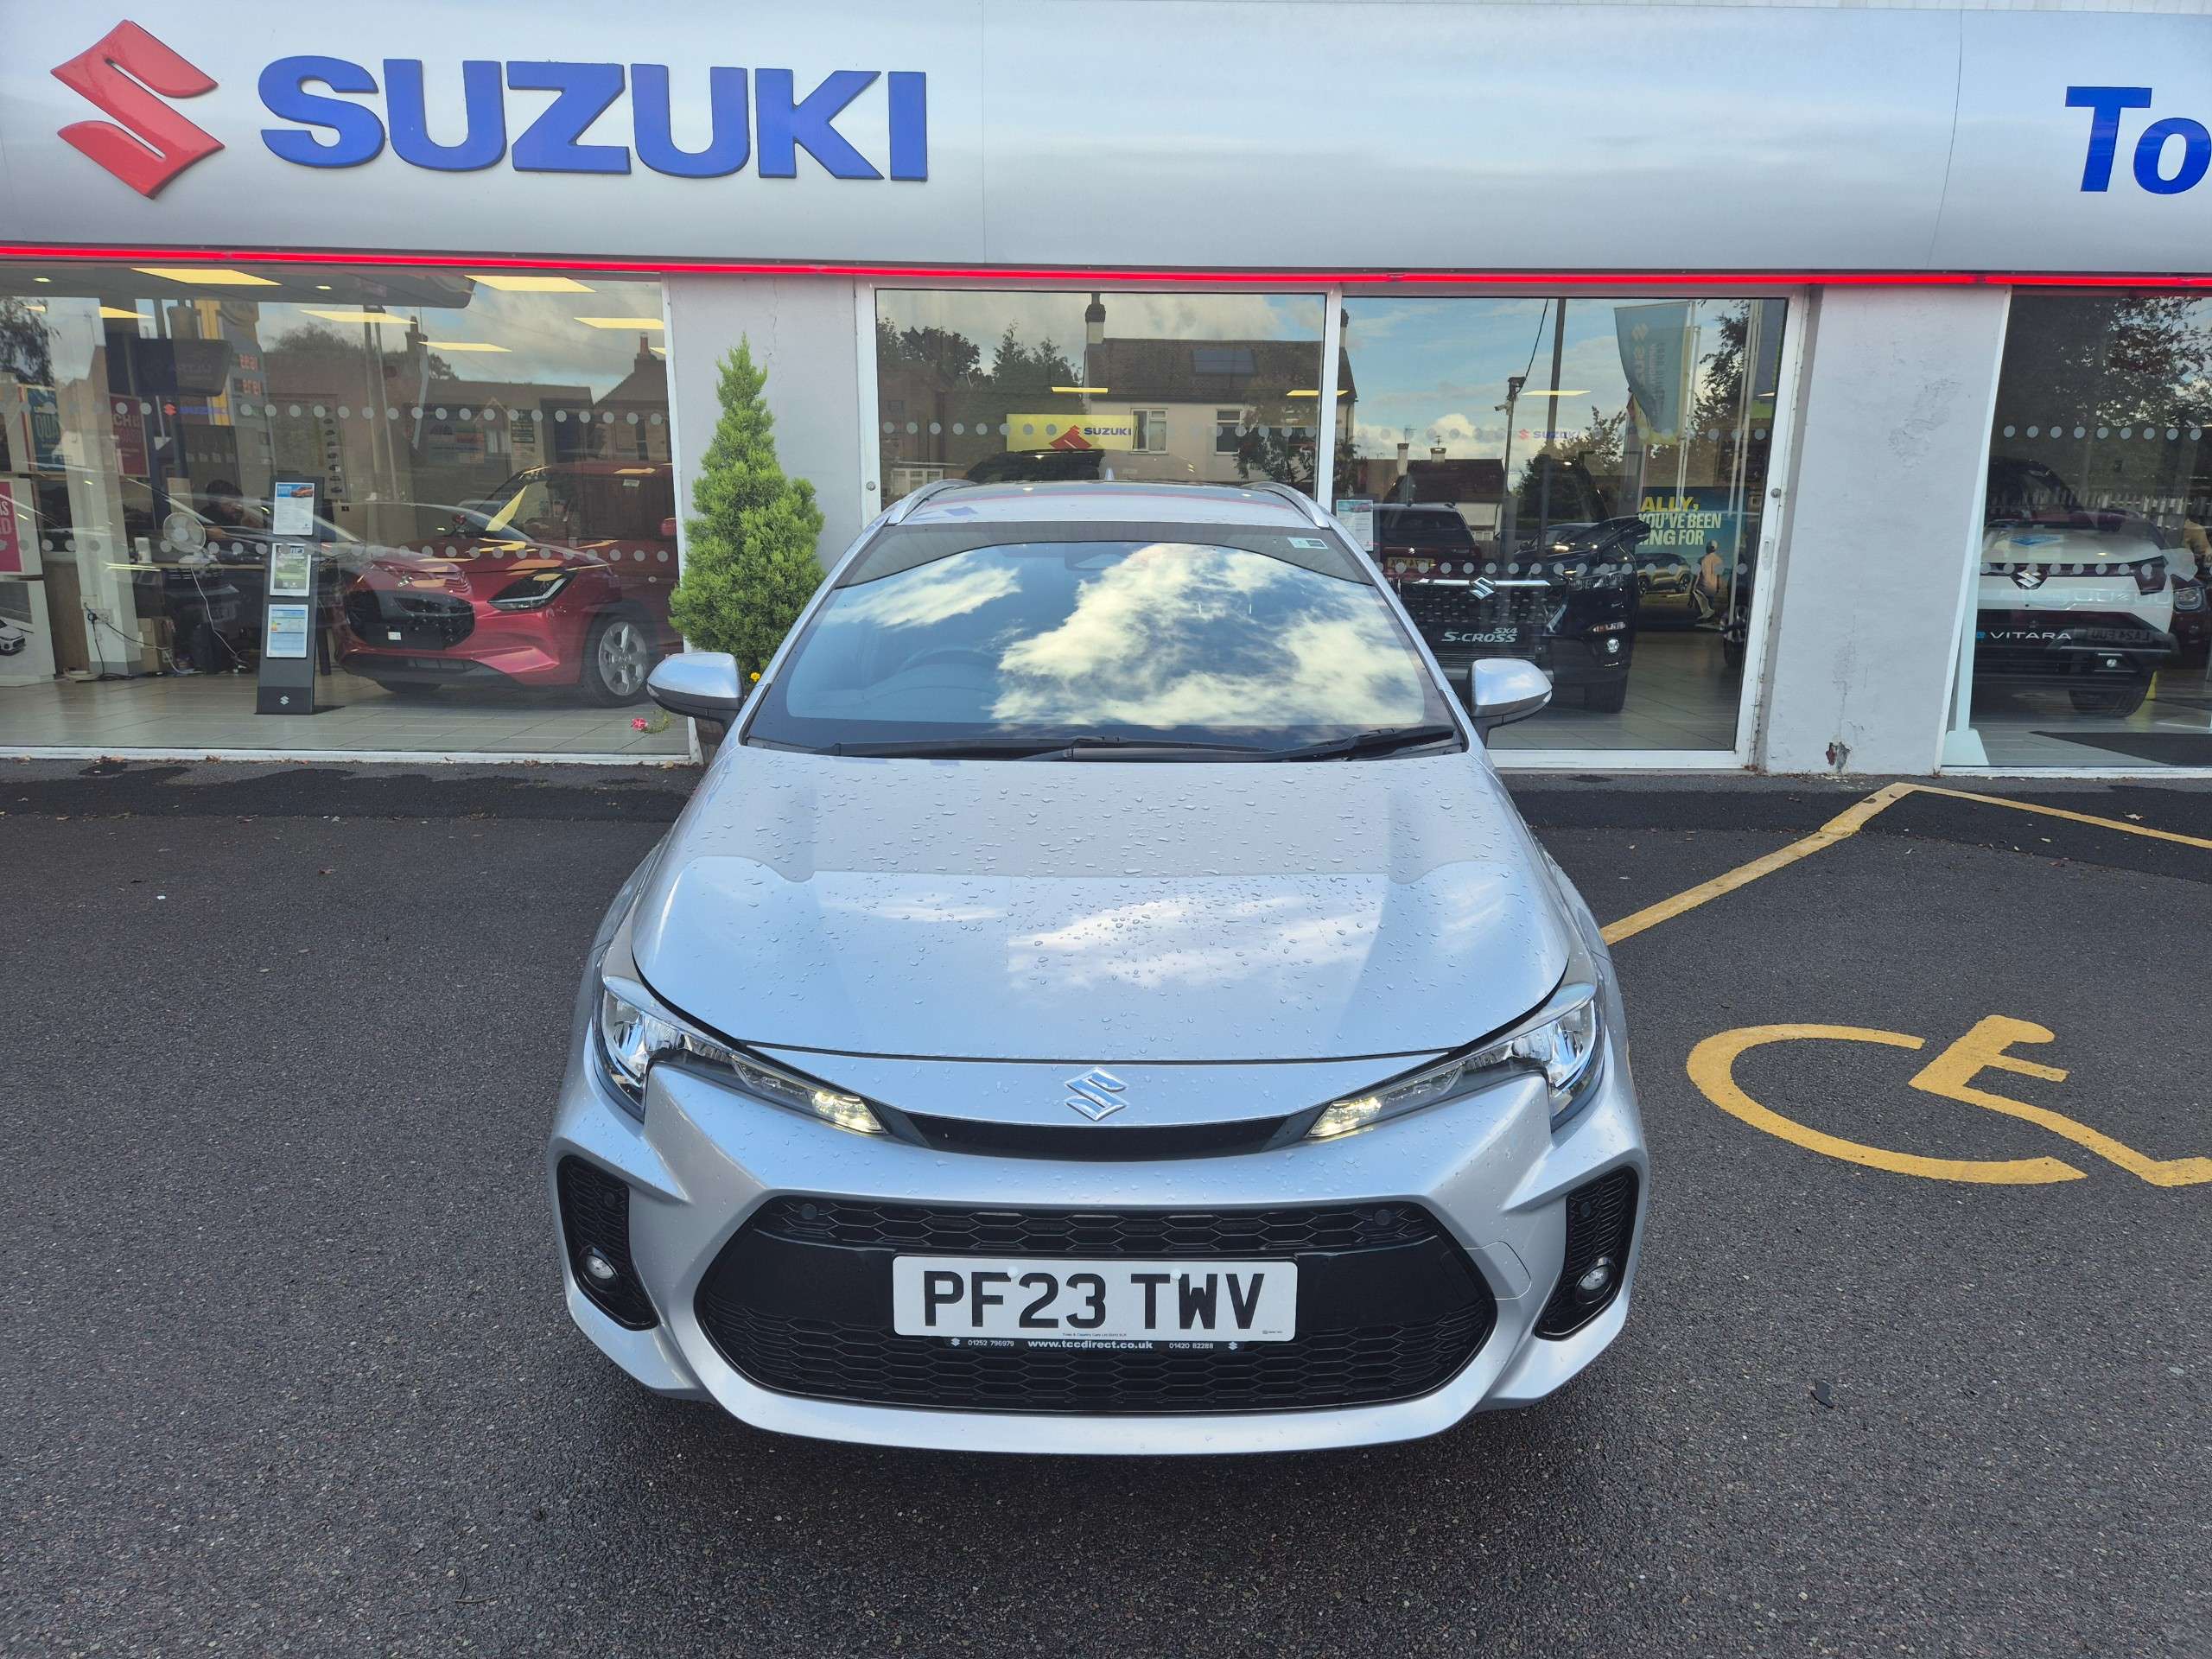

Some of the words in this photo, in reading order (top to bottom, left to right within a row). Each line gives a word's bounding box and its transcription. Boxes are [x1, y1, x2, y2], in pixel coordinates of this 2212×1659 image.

[257, 54, 928, 182] SUZUKI
[2065, 86, 2212, 195] To
[1084, 427, 1132, 435] SUZUKI
[1688, 512, 1722, 529] BEEN
[1678, 529, 1705, 546] FOR
[1990, 632, 2072, 640] VITARA
[923, 1270, 1107, 1329] PF23
[1130, 1273, 1265, 1330] TWV
[1027, 1339, 1153, 1350] www.tccdirect.co.uk
